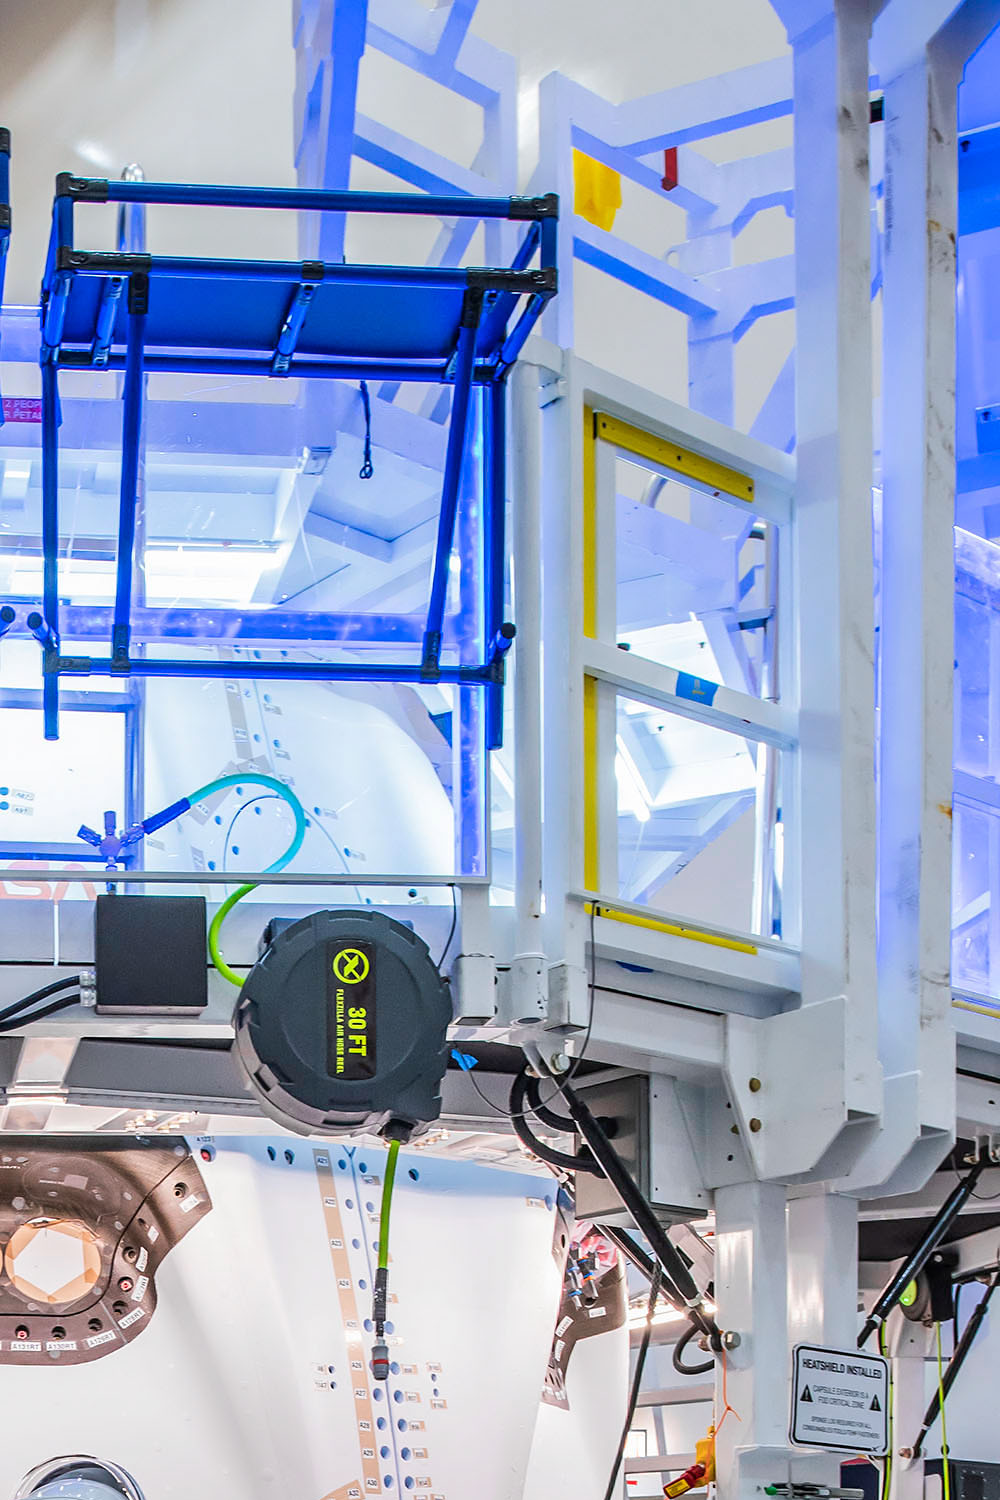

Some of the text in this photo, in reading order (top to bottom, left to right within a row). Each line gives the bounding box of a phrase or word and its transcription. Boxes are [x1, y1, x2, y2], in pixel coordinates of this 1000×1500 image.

[14, 400, 41, 409] PEOP
[336, 1024, 344, 1036] AIR
[348, 1007, 367, 1056] 30 FT
[336, 1037, 344, 1055] HOSE
[336, 1056, 344, 1074] REEL
[802, 1358, 882, 1379] HEATSHIELD INSTALLED
[812, 1384, 836, 1394] CAPSULE
[836, 1387, 860, 1397] EXTERIOR
[830, 1397, 851, 1407] CRITICAL
